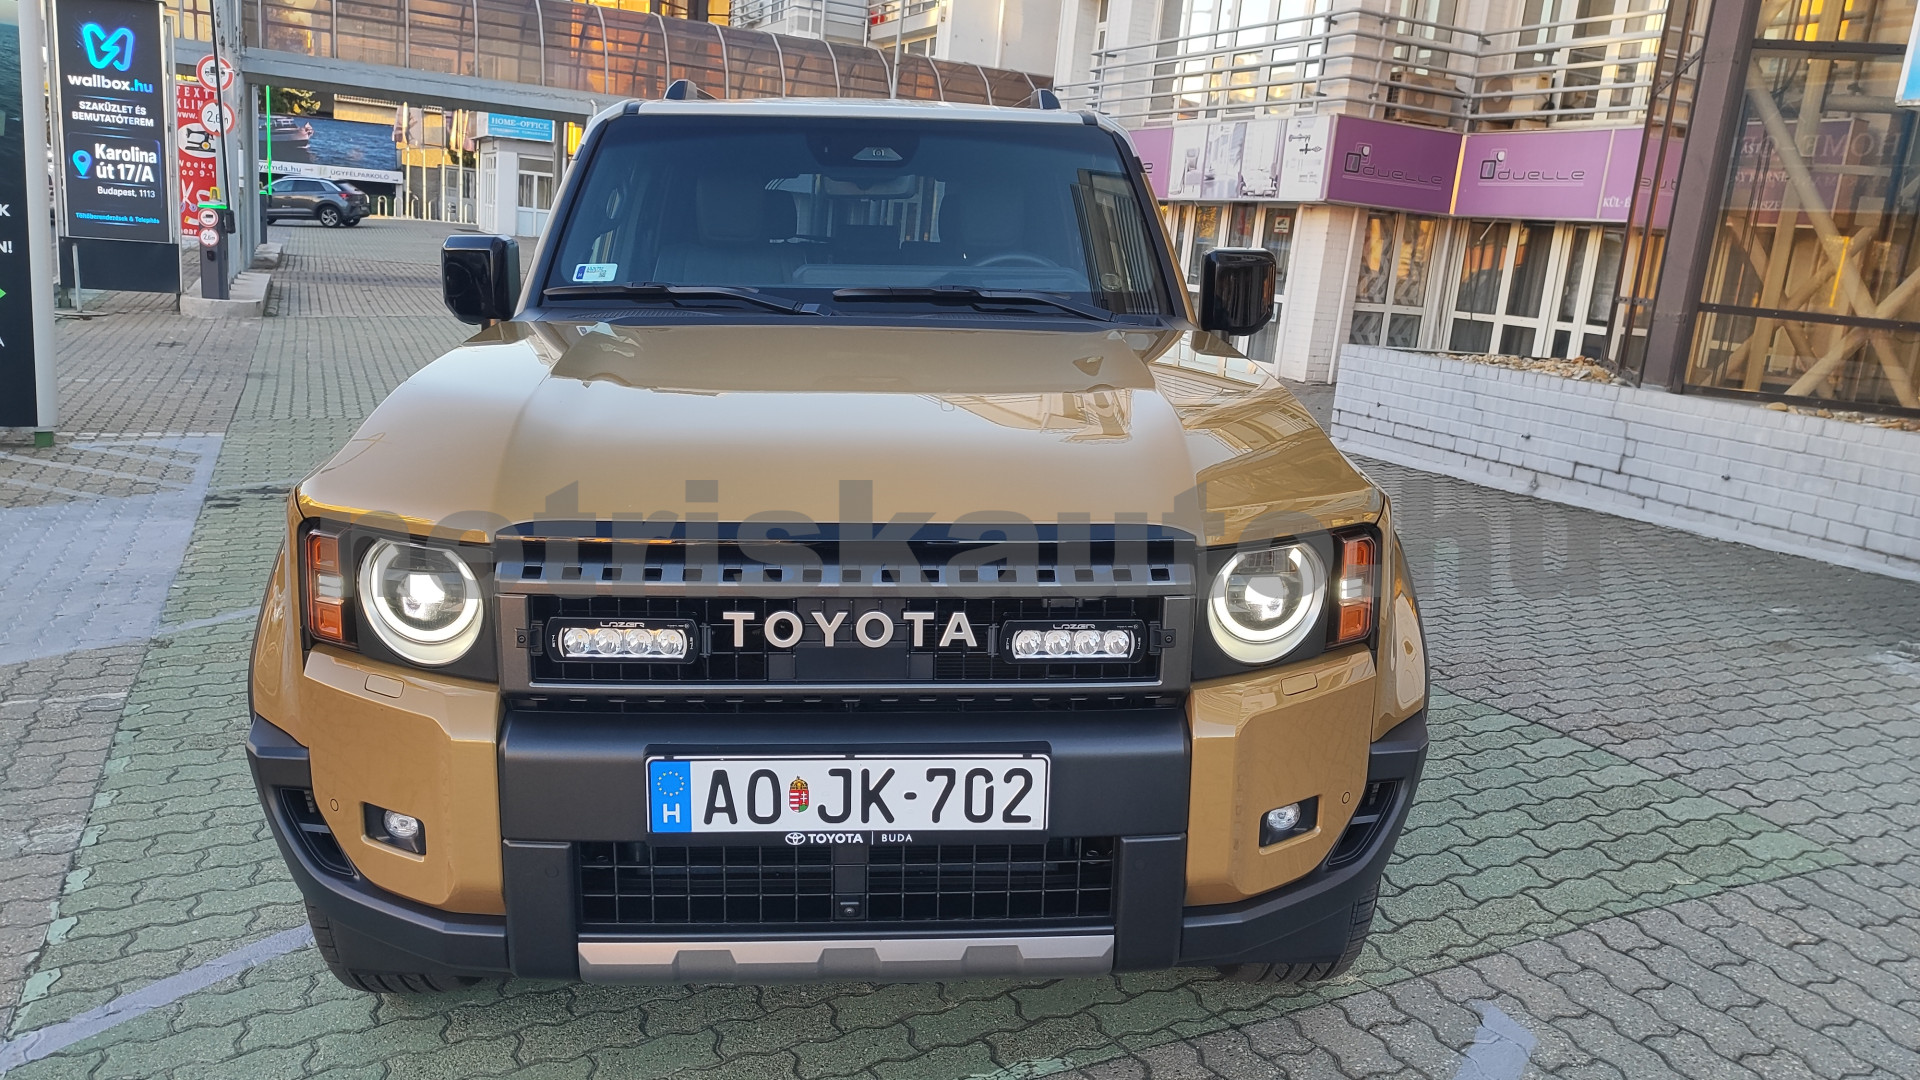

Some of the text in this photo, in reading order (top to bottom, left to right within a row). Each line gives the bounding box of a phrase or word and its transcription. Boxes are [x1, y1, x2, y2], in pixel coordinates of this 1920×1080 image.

[67, 73, 154, 94] wallbox.hu
[79, 101, 147, 115] SZAKÜZLET ÉS
[71, 111, 154, 127] BEMUTATÓTEREM
[94, 142, 158, 164] Karolina
[96, 162, 155, 183] út 17/A
[97, 186, 156, 198] Budapest, 1113
[600, 620, 645, 629] LAZER
[722, 610, 978, 648] TOYOTA
[662, 767, 1034, 826] H AO JK-702
[807, 833, 914, 845] TOYOTA BUDA
